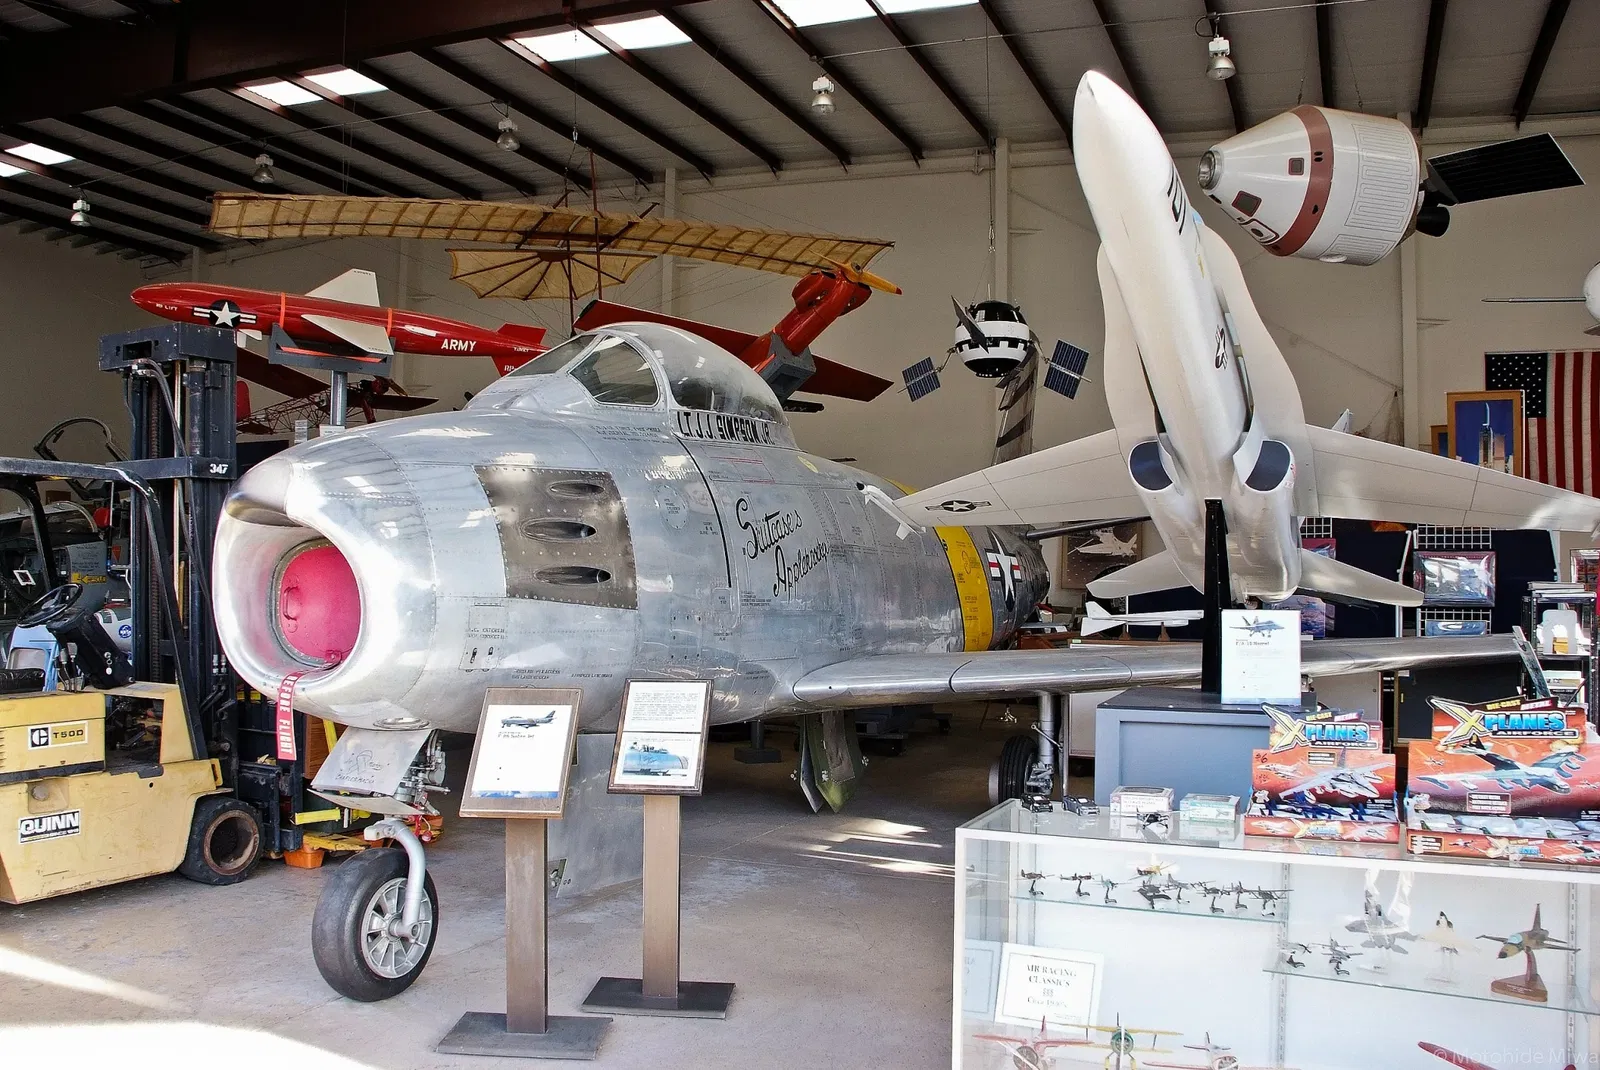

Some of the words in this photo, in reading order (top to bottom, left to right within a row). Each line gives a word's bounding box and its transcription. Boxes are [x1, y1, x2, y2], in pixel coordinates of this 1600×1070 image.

[441, 338, 476, 352] ARMY
[209, 463, 228, 474] 347
[278, 718, 294, 754] FLIGHT
[20, 812, 80, 836] QUINN
[1026, 963, 1040, 973] AIR
[1042, 965, 1077, 977] RACING
[1028, 975, 1071, 987] CLASSICS
